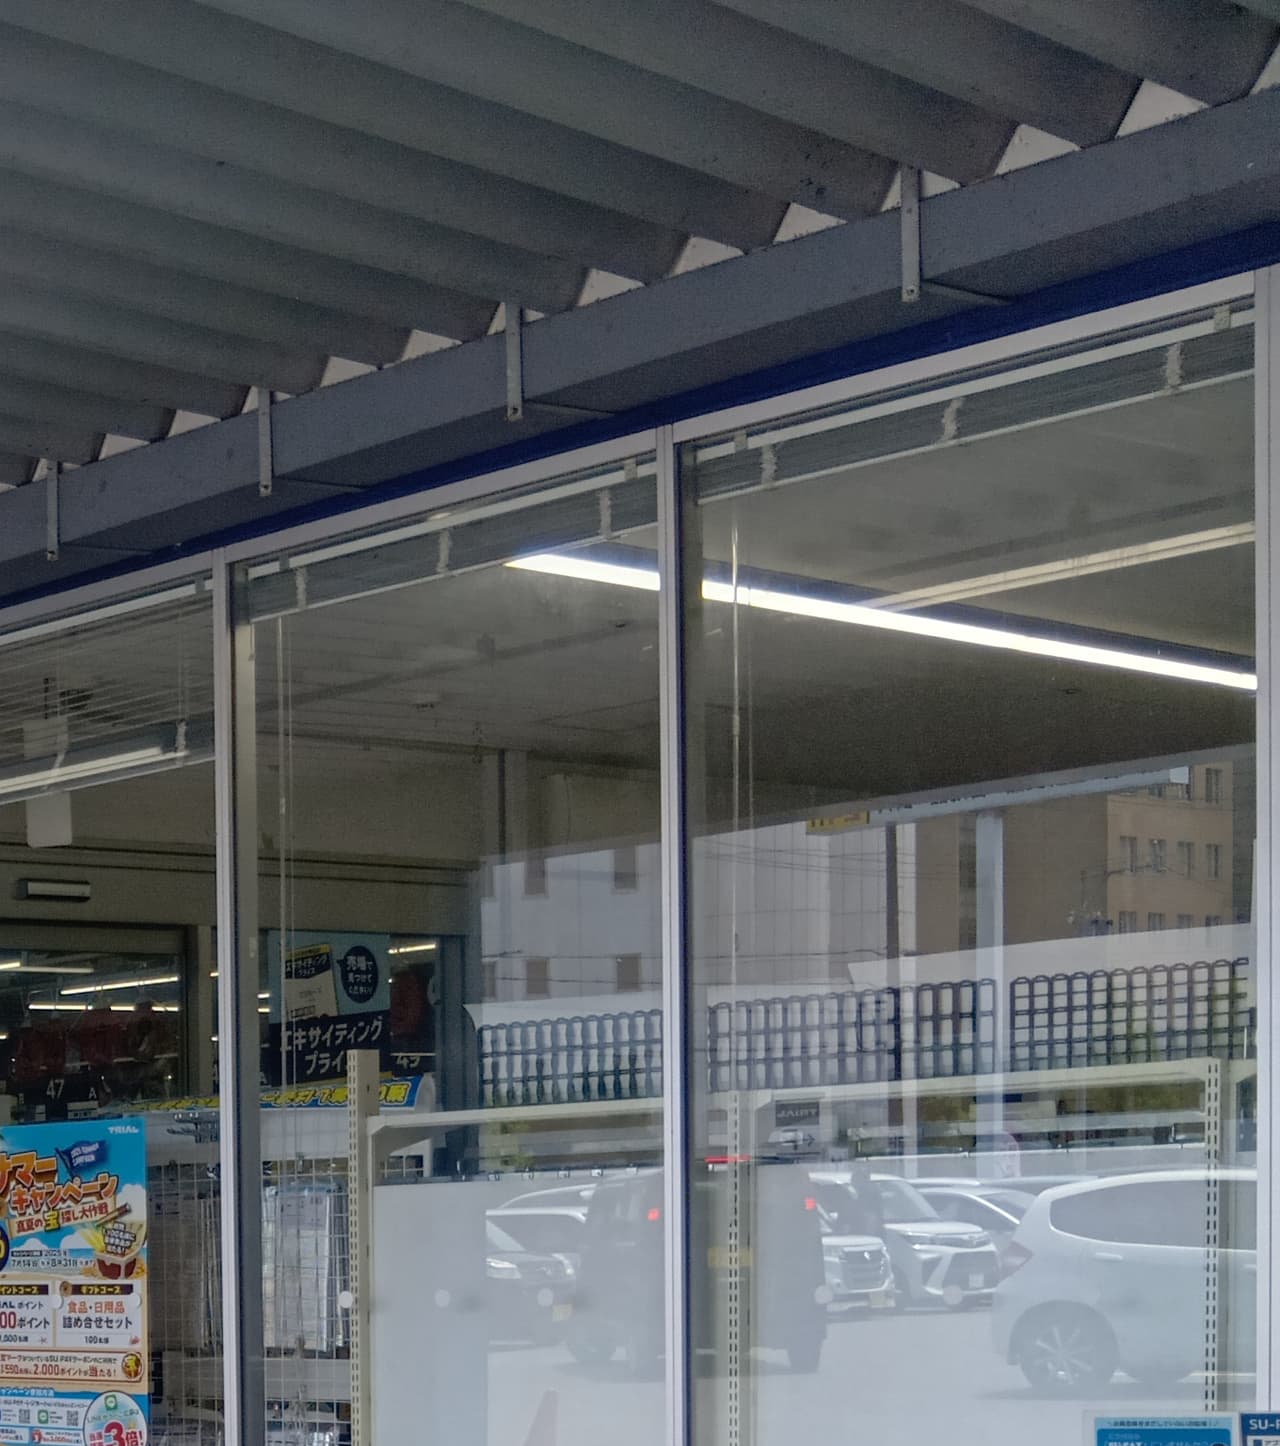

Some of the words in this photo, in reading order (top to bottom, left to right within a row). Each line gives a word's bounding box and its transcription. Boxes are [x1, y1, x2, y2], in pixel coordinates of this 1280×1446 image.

[305, 1051, 348, 1075] プライ
[108, 1126, 139, 1134] TRIAL
[11, 1172, 119, 1214] キャンペーン
[80, 1286, 121, 1294] ギフトコース
[17, 1301, 44, 1309] ポイント
[67, 1301, 125, 1314] 食品・日用品
[63, 1317, 133, 1329] 詰め合せセット
